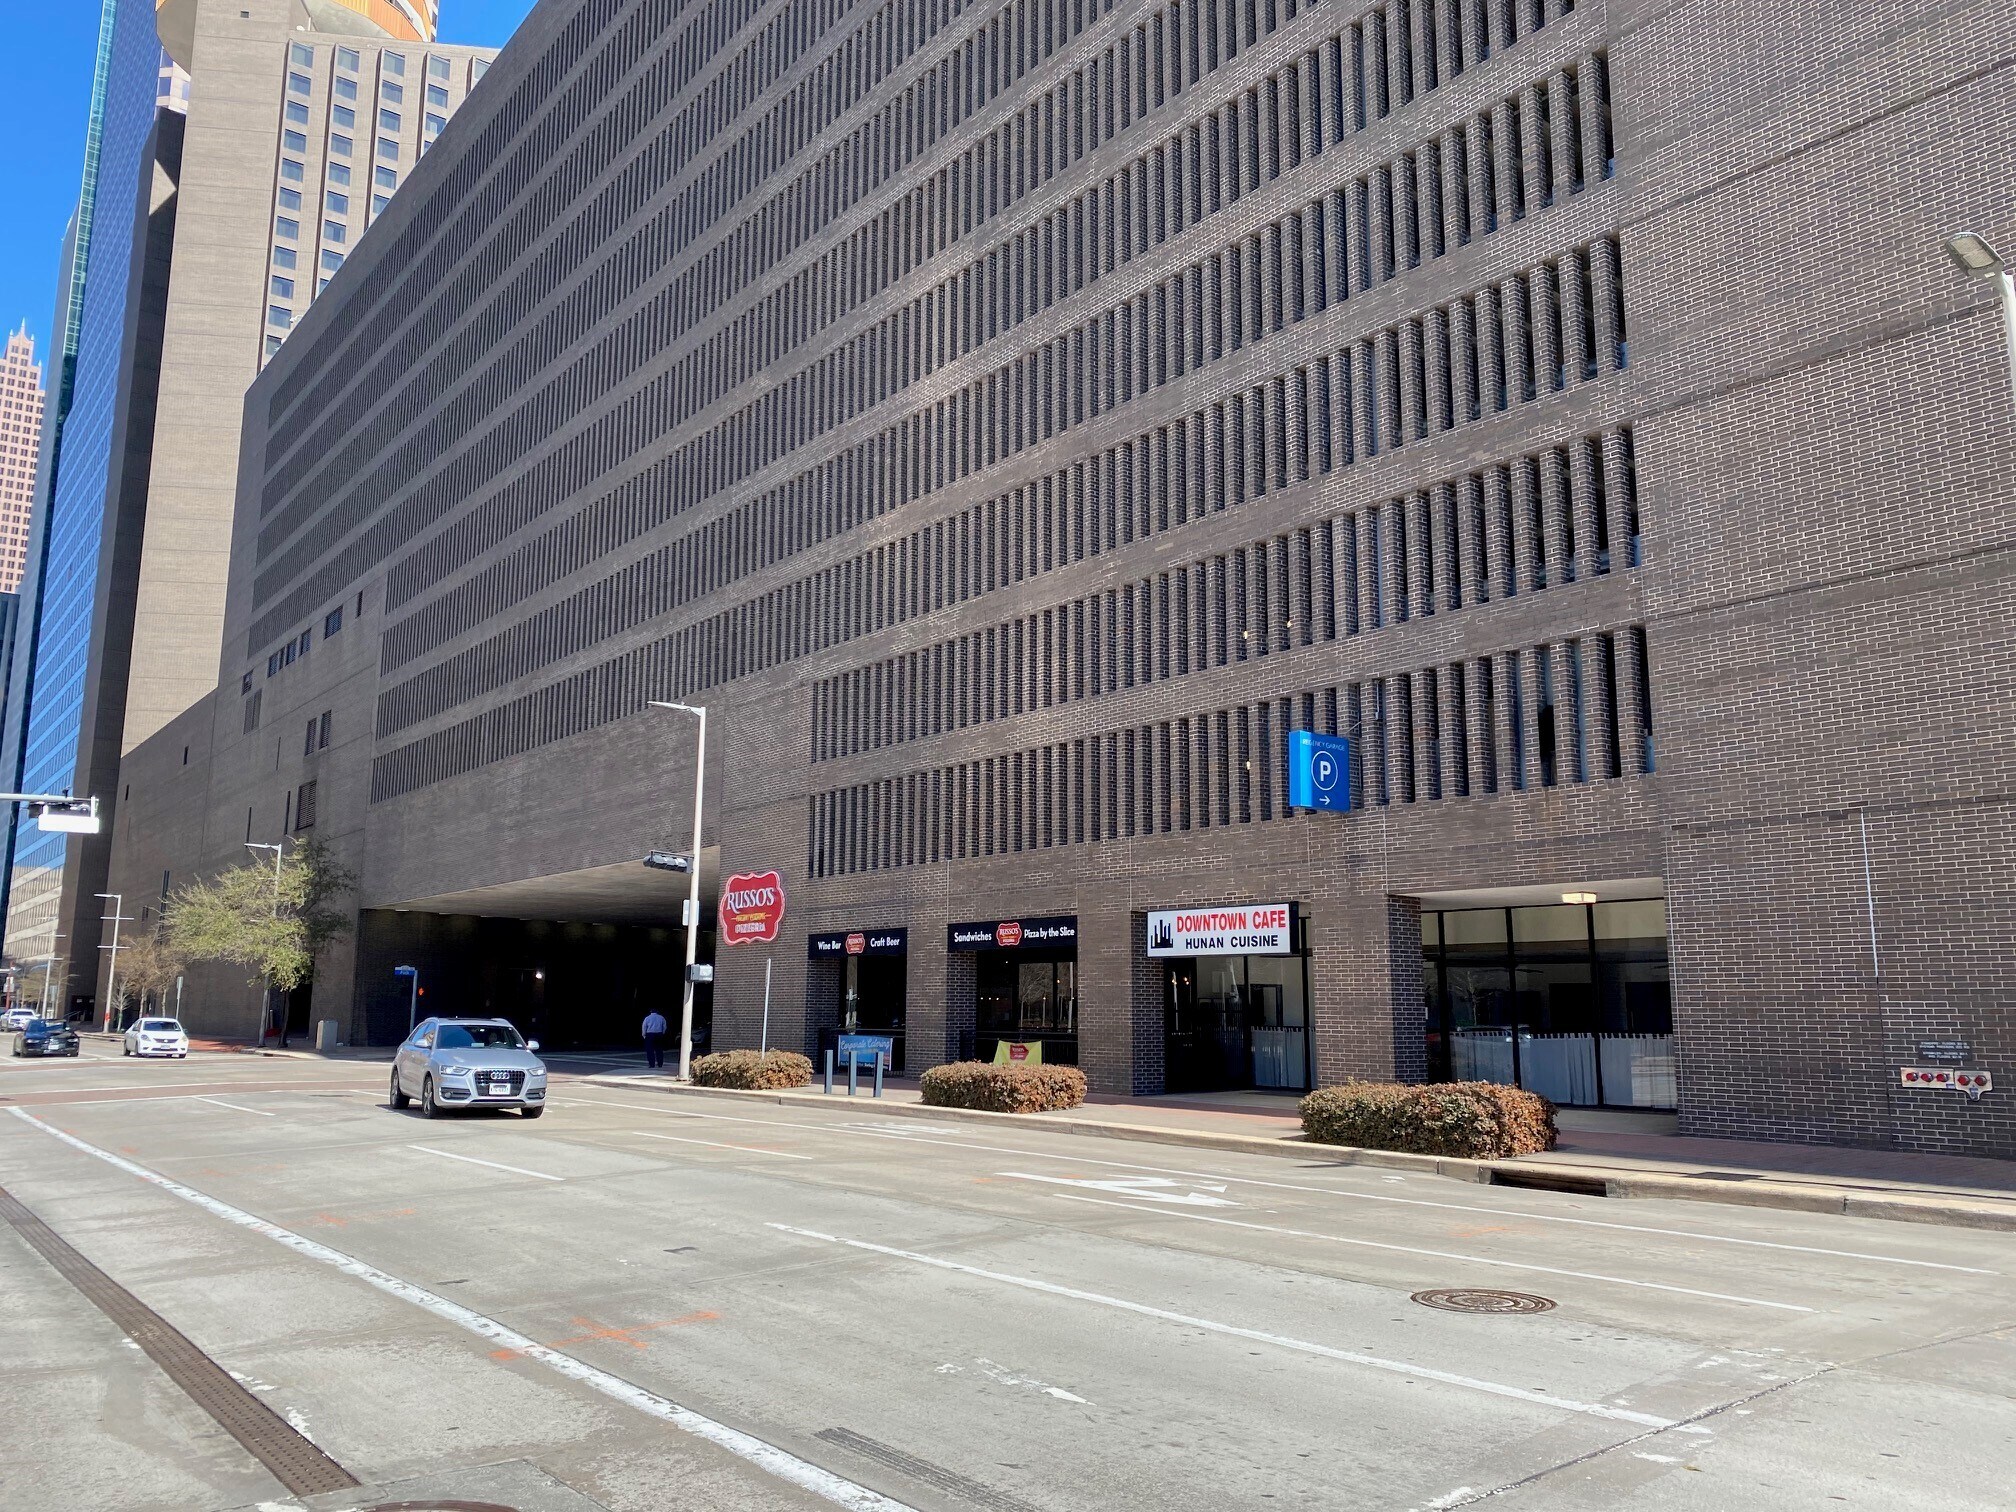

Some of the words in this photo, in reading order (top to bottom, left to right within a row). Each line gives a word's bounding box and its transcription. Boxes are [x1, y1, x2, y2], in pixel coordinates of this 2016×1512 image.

[1320, 760, 1331, 782] P
[1176, 912, 1247, 933] DOWNTOWN
[1252, 909, 1286, 930] CAFE
[954, 931, 992, 943] Sandwiches
[1024, 928, 1040, 939] Pizza
[1040, 926, 1048, 940] by
[1048, 926, 1059, 938] the
[1059, 925, 1075, 937] Slice
[817, 941, 831, 950] Wine
[831, 940, 842, 950] Bar
[870, 937, 885, 948] Craft
[886, 936, 900, 947] Beer
[1186, 936, 1224, 949] HUNAN
[1230, 934, 1279, 948] CUISINE
